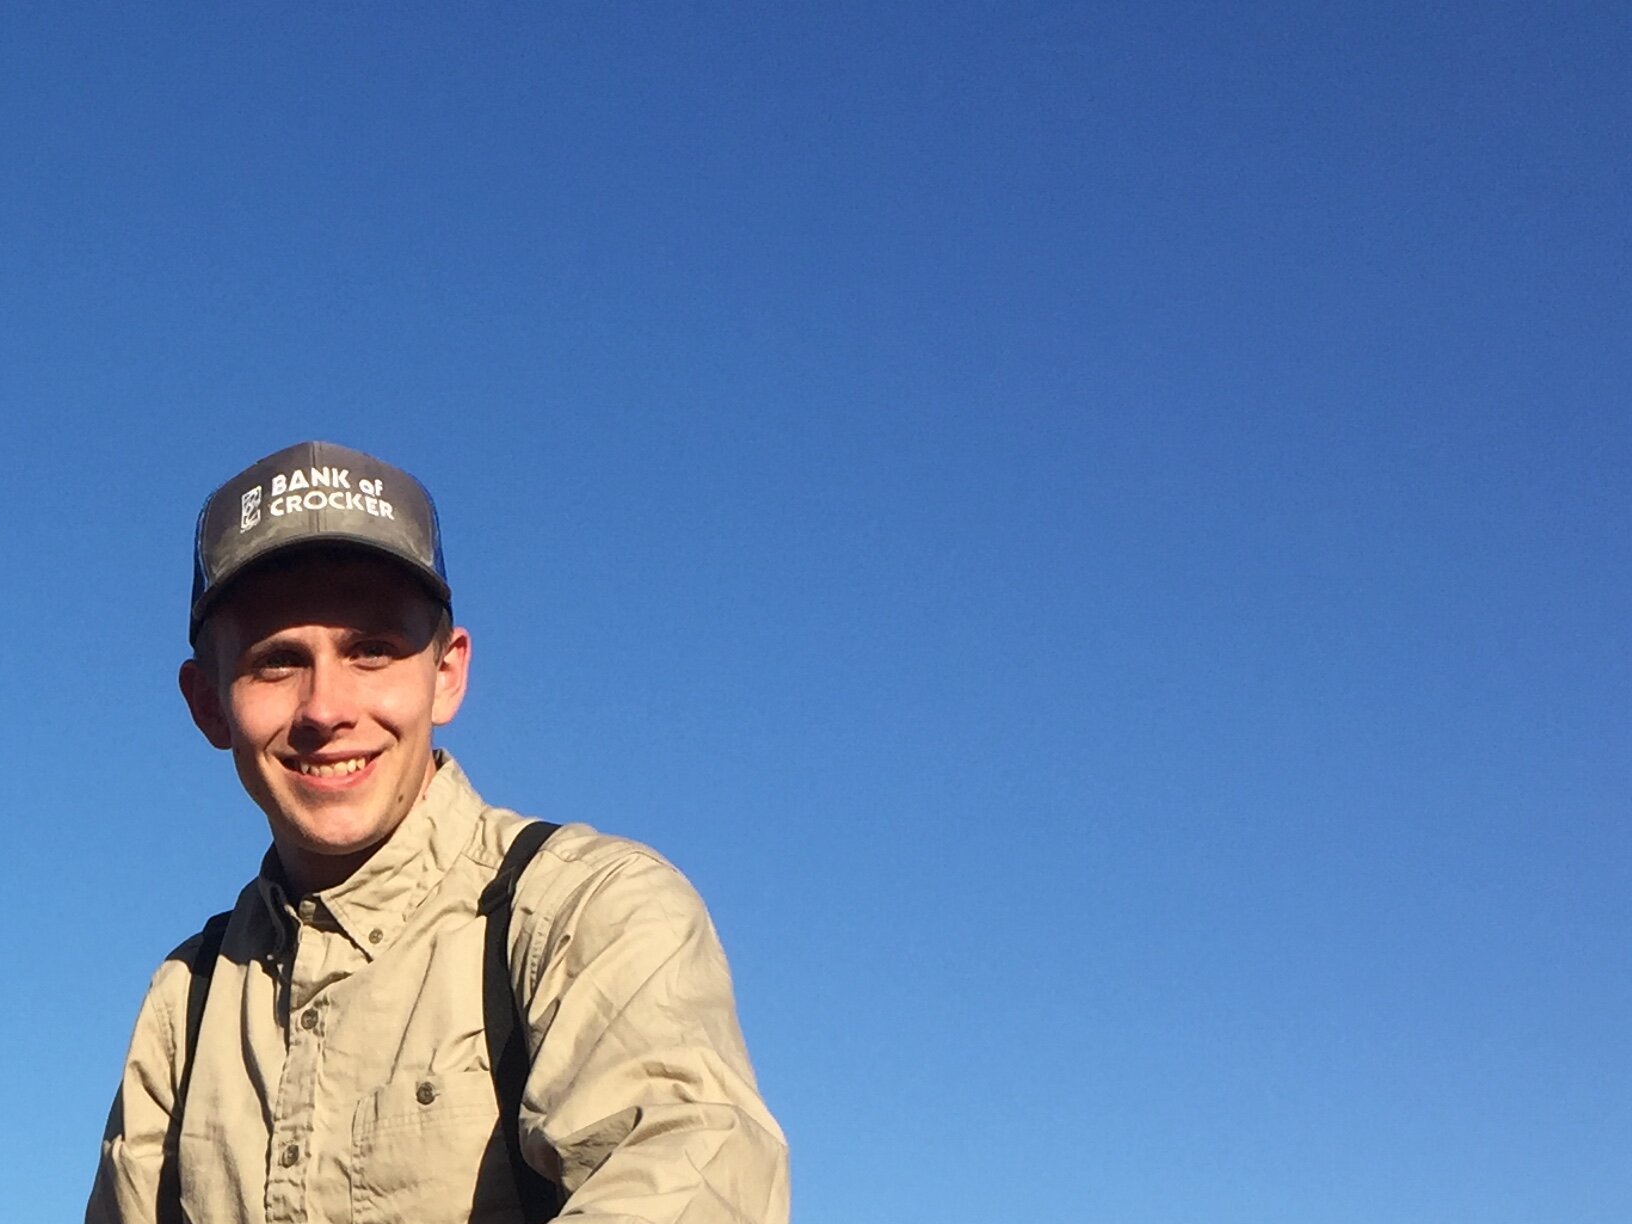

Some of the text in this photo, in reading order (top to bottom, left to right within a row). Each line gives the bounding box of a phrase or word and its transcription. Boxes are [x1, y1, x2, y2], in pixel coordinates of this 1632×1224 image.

[271, 467, 383, 498] BANK of
[269, 491, 395, 520] CROCKER
